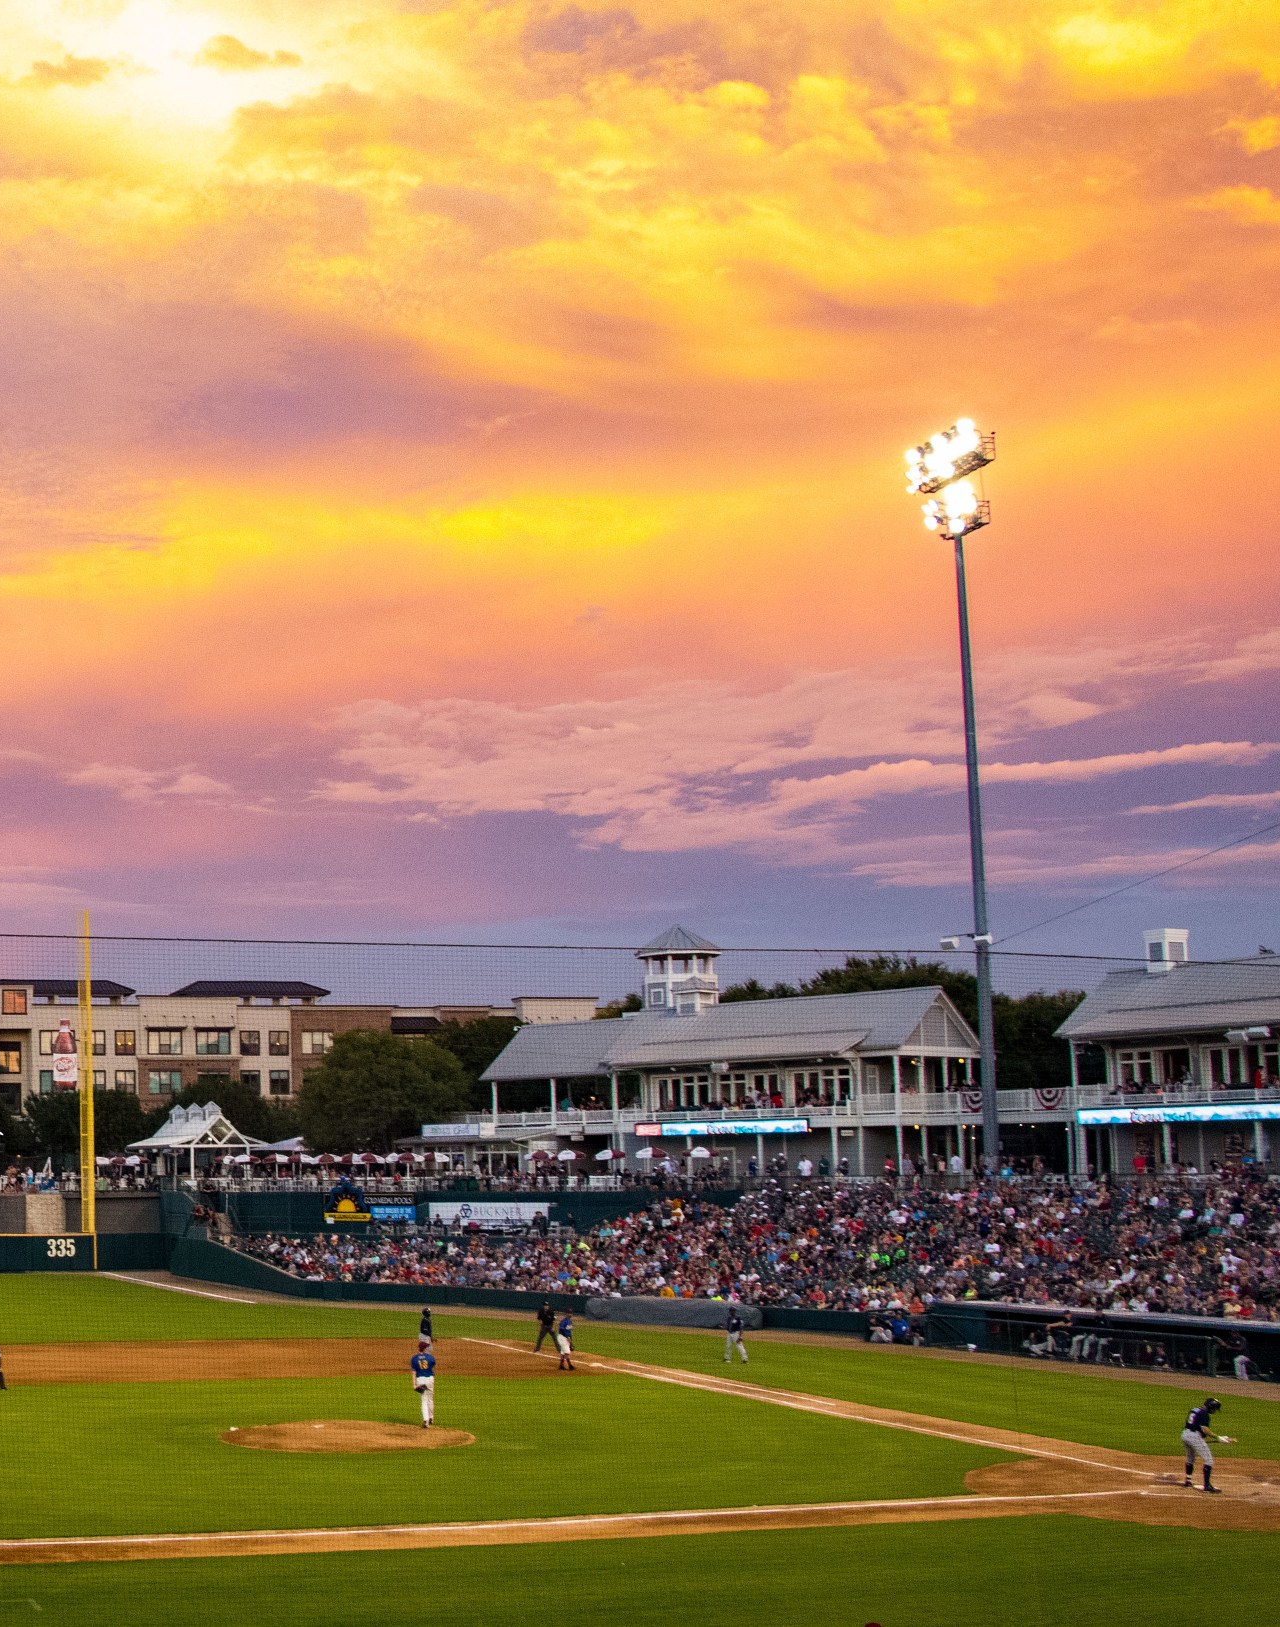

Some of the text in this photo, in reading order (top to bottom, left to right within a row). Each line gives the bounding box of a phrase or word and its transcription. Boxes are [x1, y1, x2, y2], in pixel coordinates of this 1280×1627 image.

[394, 1196, 412, 1204] POOLS
[474, 1206, 522, 1217] BUCKNER
[47, 1238, 76, 1257] 335
